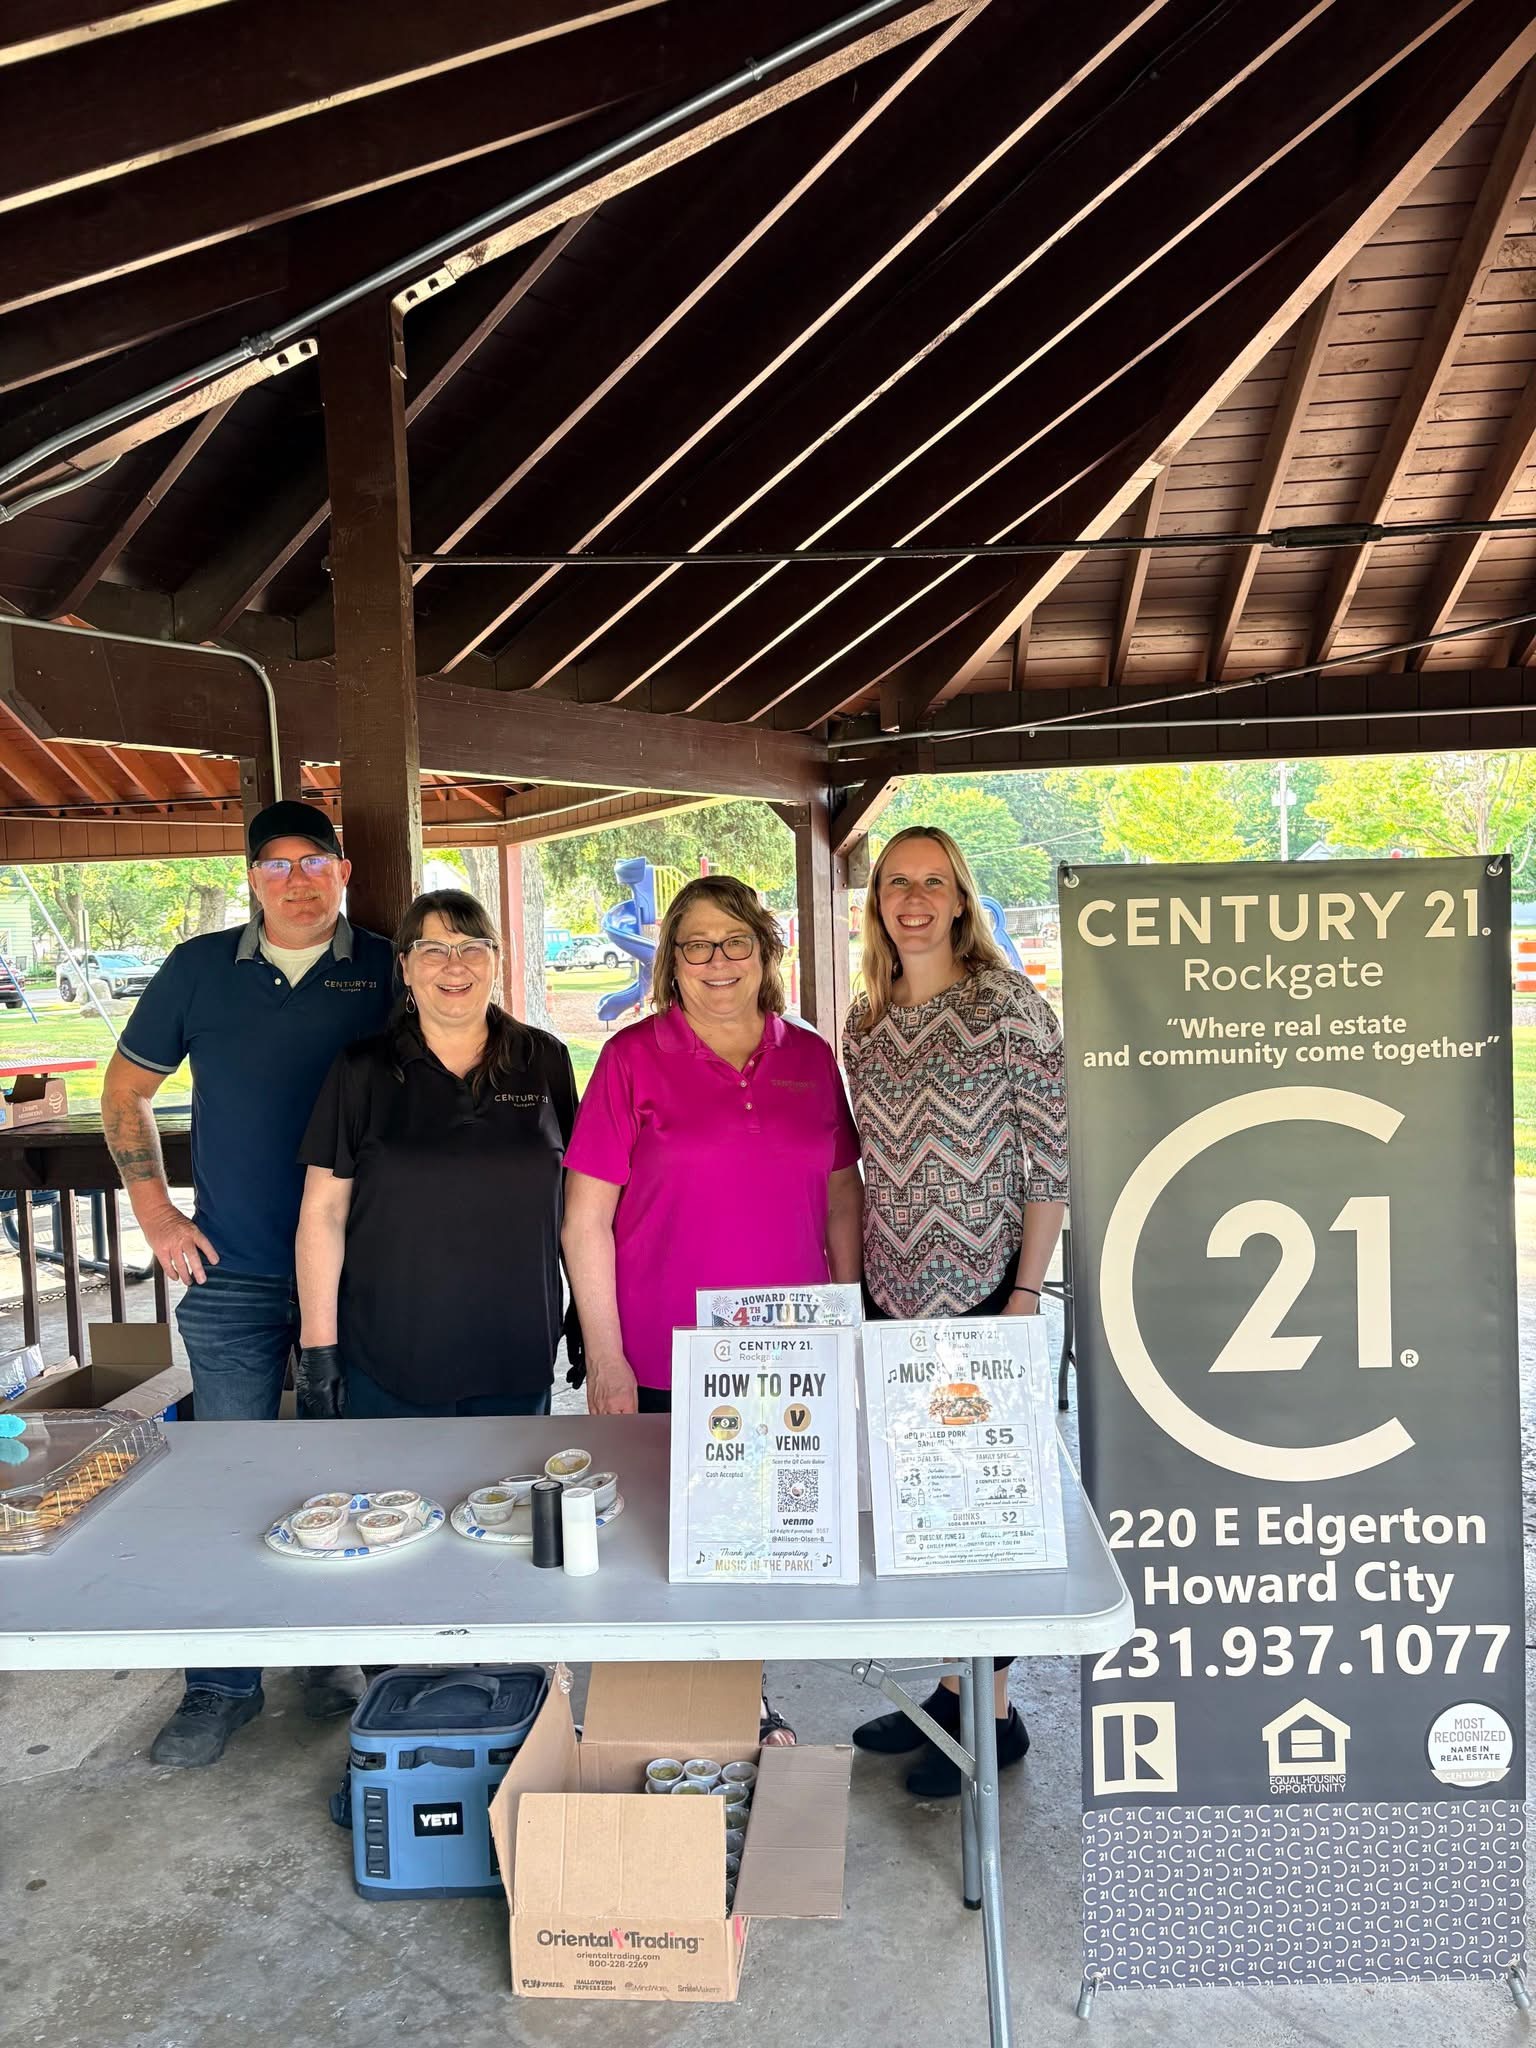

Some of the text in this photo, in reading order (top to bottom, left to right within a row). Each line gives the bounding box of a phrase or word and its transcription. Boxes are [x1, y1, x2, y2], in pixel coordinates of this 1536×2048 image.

[1077, 891, 1405, 946] CENTURY
[1184, 955, 1384, 999] Rockgate
[324, 980, 367, 988] CENTURY
[1274, 1014, 1321, 1037] real
[1329, 1015, 1407, 1035] estate
[1083, 1046, 1130, 1068] and
[1138, 1042, 1288, 1069] community
[1295, 1043, 1364, 1062] come
[494, 1094, 540, 1102] CENTURY
[741, 1293, 813, 1306] HOWARD CITY
[762, 1304, 820, 1323] JULY
[739, 1341, 797, 1351] CENTURY
[971, 1359, 1014, 1381] PARK
[704, 1373, 826, 1397] HOW TO PAY
[948, 1430, 967, 1438] PORK
[985, 1428, 1014, 1446] $5
[776, 1435, 820, 1451] VENMO
[705, 1443, 745, 1461] CASH
[719, 1471, 744, 1479] Accepted
[983, 1465, 1012, 1477] $15
[782, 1518, 814, 1526] venmo
[953, 1513, 980, 1521] DRINKS
[1001, 1511, 1017, 1523] $2
[1108, 1504, 1487, 1556] 220 E Edgerton
[772, 1549, 808, 1559] supporting
[1143, 1560, 1455, 1614] Howard City
[1454, 1718, 1485, 1730] MOST
[1434, 1730, 1506, 1743] RECOGNIZED
[1440, 1753, 1500, 1762] REAL ESTATE
[1269, 1774, 1346, 1785] EQUAL HOUSING
[1270, 1783, 1346, 1794] OPPORTUNITY
[420, 1812, 458, 1827] YETI
[1098, 1804, 1519, 1823] 21 21 21 21 21 21 21 21 21 21 21 21 21 21 21
[1086, 1823, 1506, 1844] 21 21 21 21 21 21 21 21 21 21 21 21 21 21 21
[536, 1929, 613, 1948] Oriental
[576, 1952, 660, 1961] orientaltrading.com
[589, 1960, 649, 1969] 800-228-2269
